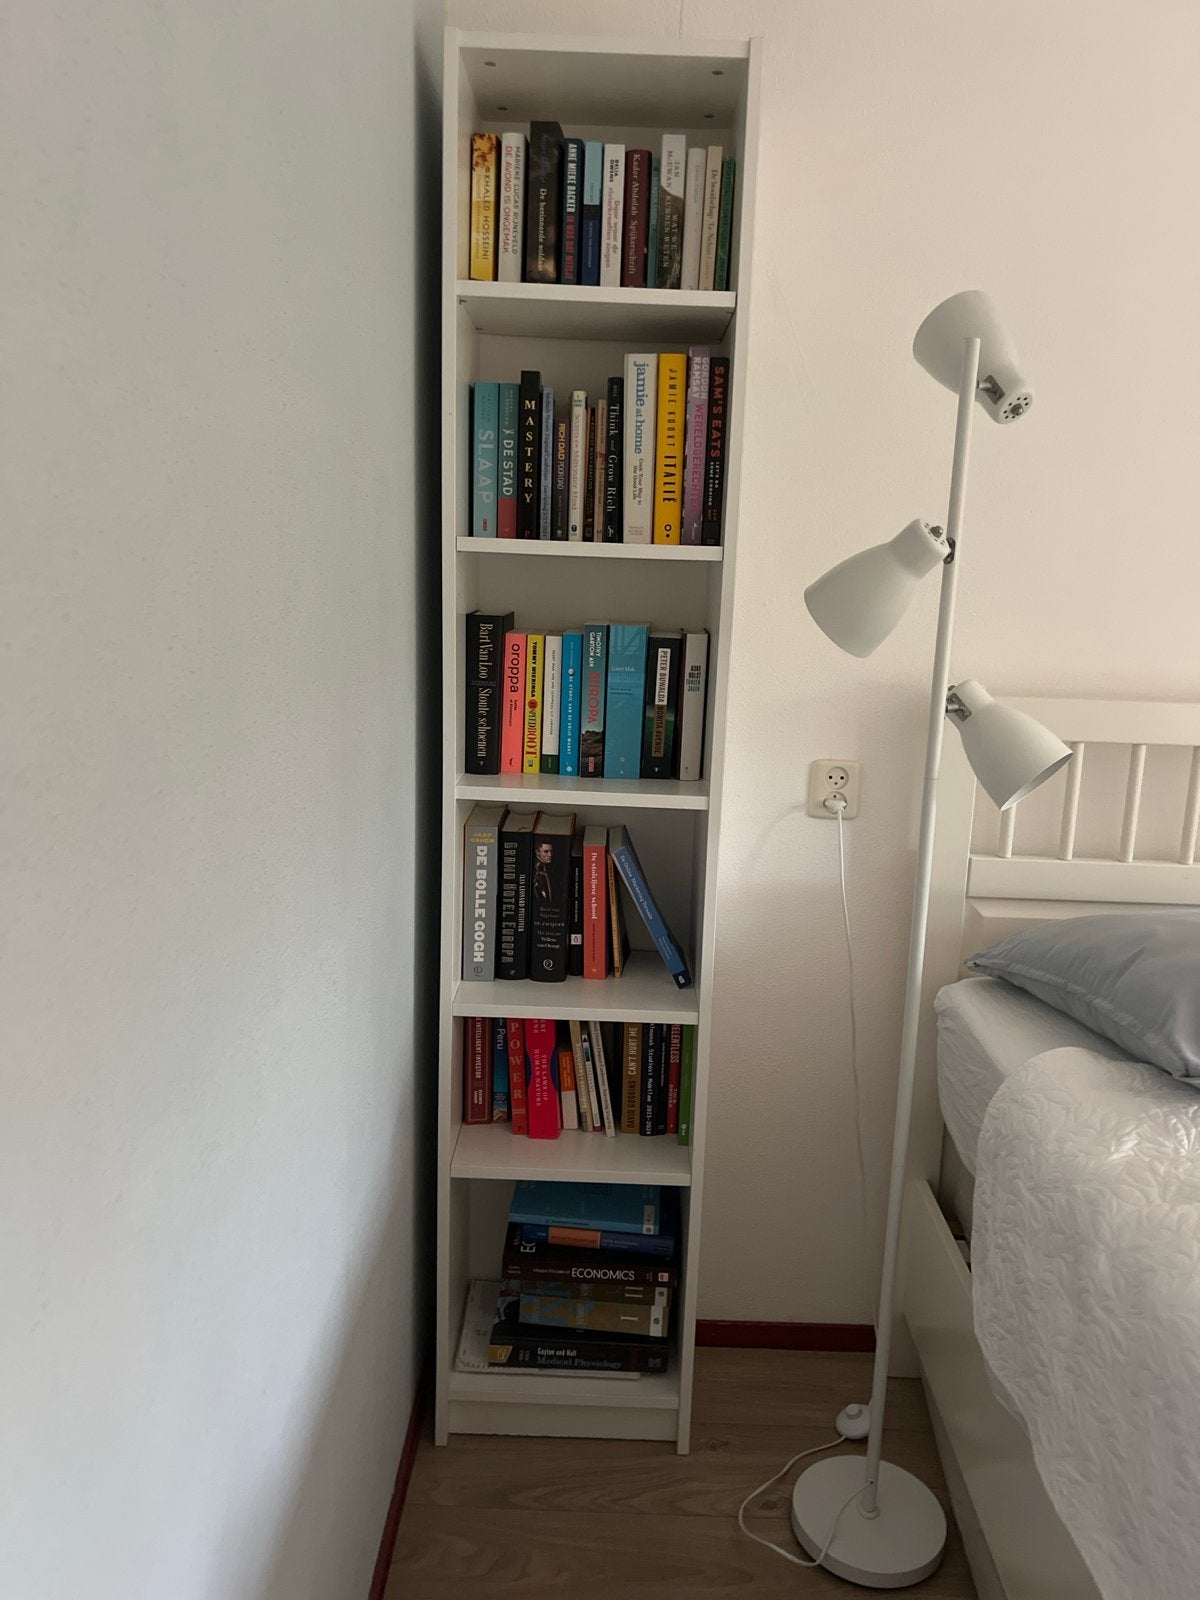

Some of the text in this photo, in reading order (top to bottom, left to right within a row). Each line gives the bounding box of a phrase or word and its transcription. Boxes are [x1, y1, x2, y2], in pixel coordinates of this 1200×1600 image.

[566, 143, 578, 213] ANNE MIEKE BACKER
[666, 150, 674, 189] McEWAN
[503, 146, 512, 254] DE AVOND IS ONGEMAK
[512, 184, 520, 209] LUCAS
[539, 188, 548, 200] De
[706, 170, 719, 217] De boodschap
[512, 212, 520, 254] RIJNEVELD
[604, 188, 614, 269] rivierkreeften zingen
[629, 154, 641, 274] Kader Abdolah Spijkerschrift
[663, 196, 672, 268] KUNNEN WETEN
[482, 215, 490, 260] HOSSEINI
[612, 245, 619, 255] de
[672, 235, 678, 250] WE
[537, 244, 546, 272] soldaat
[692, 356, 702, 400] RAMSAY
[700, 356, 710, 400] GORDON
[609, 404, 620, 437] Think
[634, 362, 649, 455] jamie at home
[710, 366, 726, 459] SAM'S EATS
[524, 400, 536, 504] MASTERY
[558, 424, 566, 442] RICH
[558, 443, 566, 461] DAD
[662, 368, 678, 504] JAMIE KOOKT ITALIË
[478, 430, 494, 504] SLAAP
[502, 440, 514, 497] DE STAD
[556, 462, 564, 478] POOR
[572, 452, 581, 490] Millionaire
[606, 455, 618, 483] Grow
[690, 404, 704, 513] WERELDGERECHTEN
[556, 478, 564, 490] DAD
[571, 491, 579, 512] Mind
[606, 488, 618, 513] Rich
[636, 490, 644, 500] Way
[714, 481, 720, 490] DO
[479, 624, 494, 642] Bart
[478, 663, 493, 680] Loo
[479, 643, 494, 663] Van
[507, 644, 521, 693] oroppa
[530, 666, 538, 698] WIERINGA
[657, 650, 668, 704] PETER BUWALDA
[478, 688, 492, 717] Stoute
[587, 672, 600, 725] EUROPA
[477, 718, 491, 758] schoenen
[654, 706, 665, 755] BONITA AVENUE
[592, 852, 598, 863] De
[590, 864, 599, 896] stoïcijnse
[622, 862, 634, 879] Online
[632, 878, 645, 903] Marketing
[473, 846, 488, 963] DE BOLLE GOGH
[501, 842, 518, 964] GRAND HOTEL EUROPA
[591, 898, 599, 920] school
[496, 1028, 507, 1050] Peru
[628, 1026, 638, 1076] CAN'T HURT ME
[510, 1022, 524, 1100] POWER
[534, 1048, 542, 1076] HUMAN
[543, 1092, 549, 1102] OF
[626, 1080, 636, 1128] DAVID GOGGINS
[572, 1266, 636, 1281] ECONOMICS
[536, 1356, 622, 1370] Medical Physiology
[537, 1347, 556, 1357] Guyton
[556, 1348, 567, 1357] and
[566, 1349, 578, 1358] Hall
